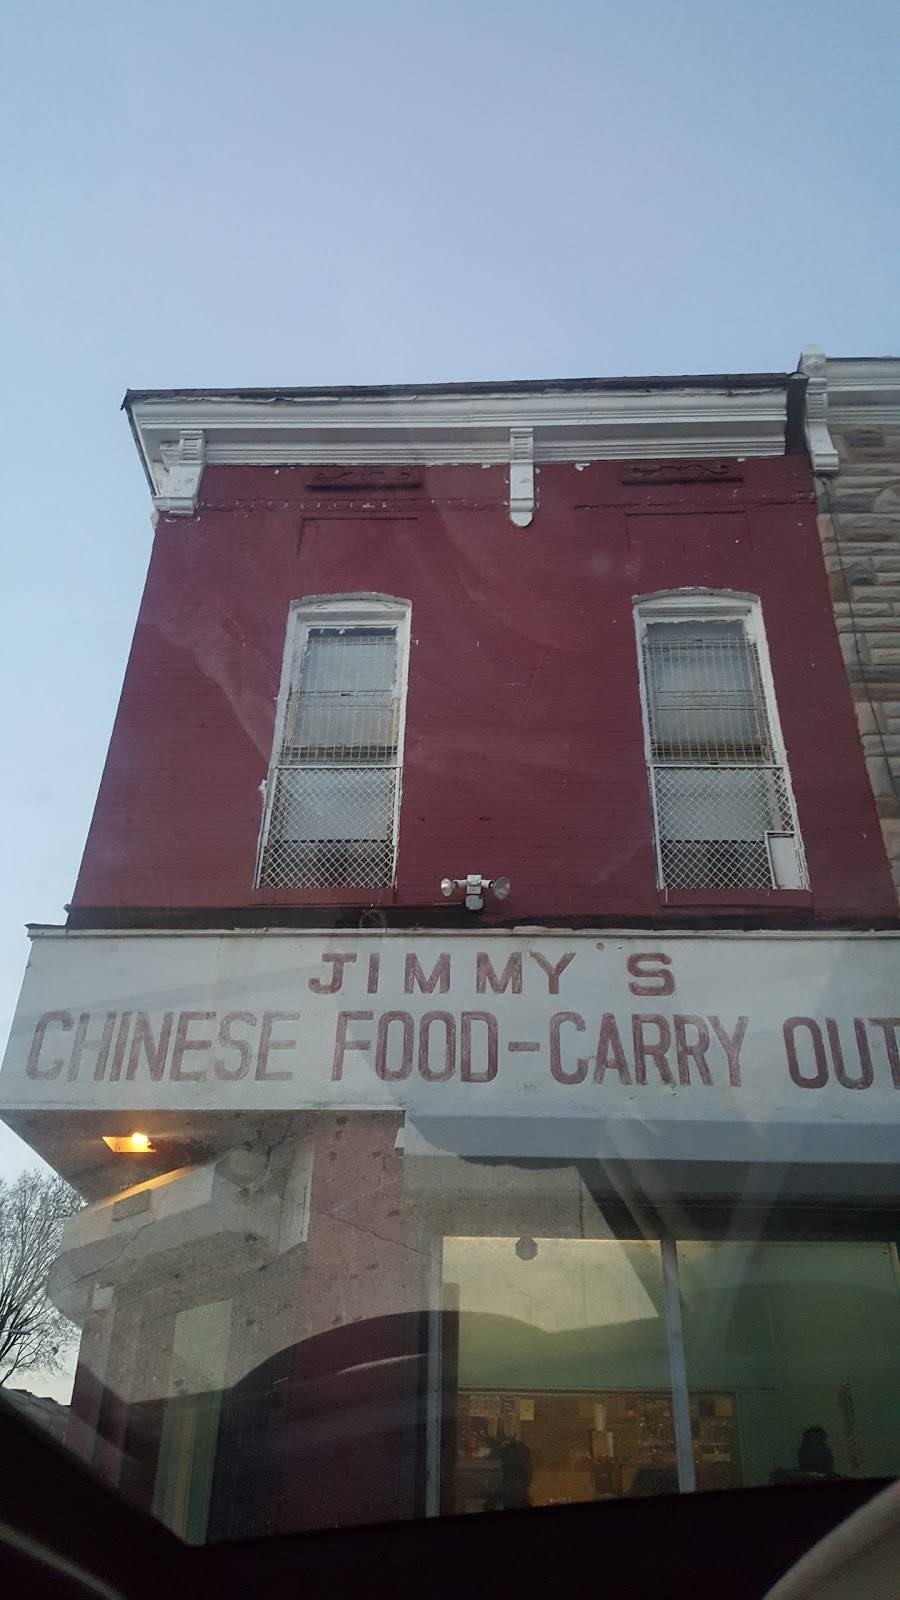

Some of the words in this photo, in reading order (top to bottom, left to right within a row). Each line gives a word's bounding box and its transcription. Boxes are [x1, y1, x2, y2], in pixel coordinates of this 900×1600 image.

[308, 952, 576, 995] JIMMY
[26, 1010, 300, 1083] CHINESE
[782, 1015, 900, 1091] OUT
